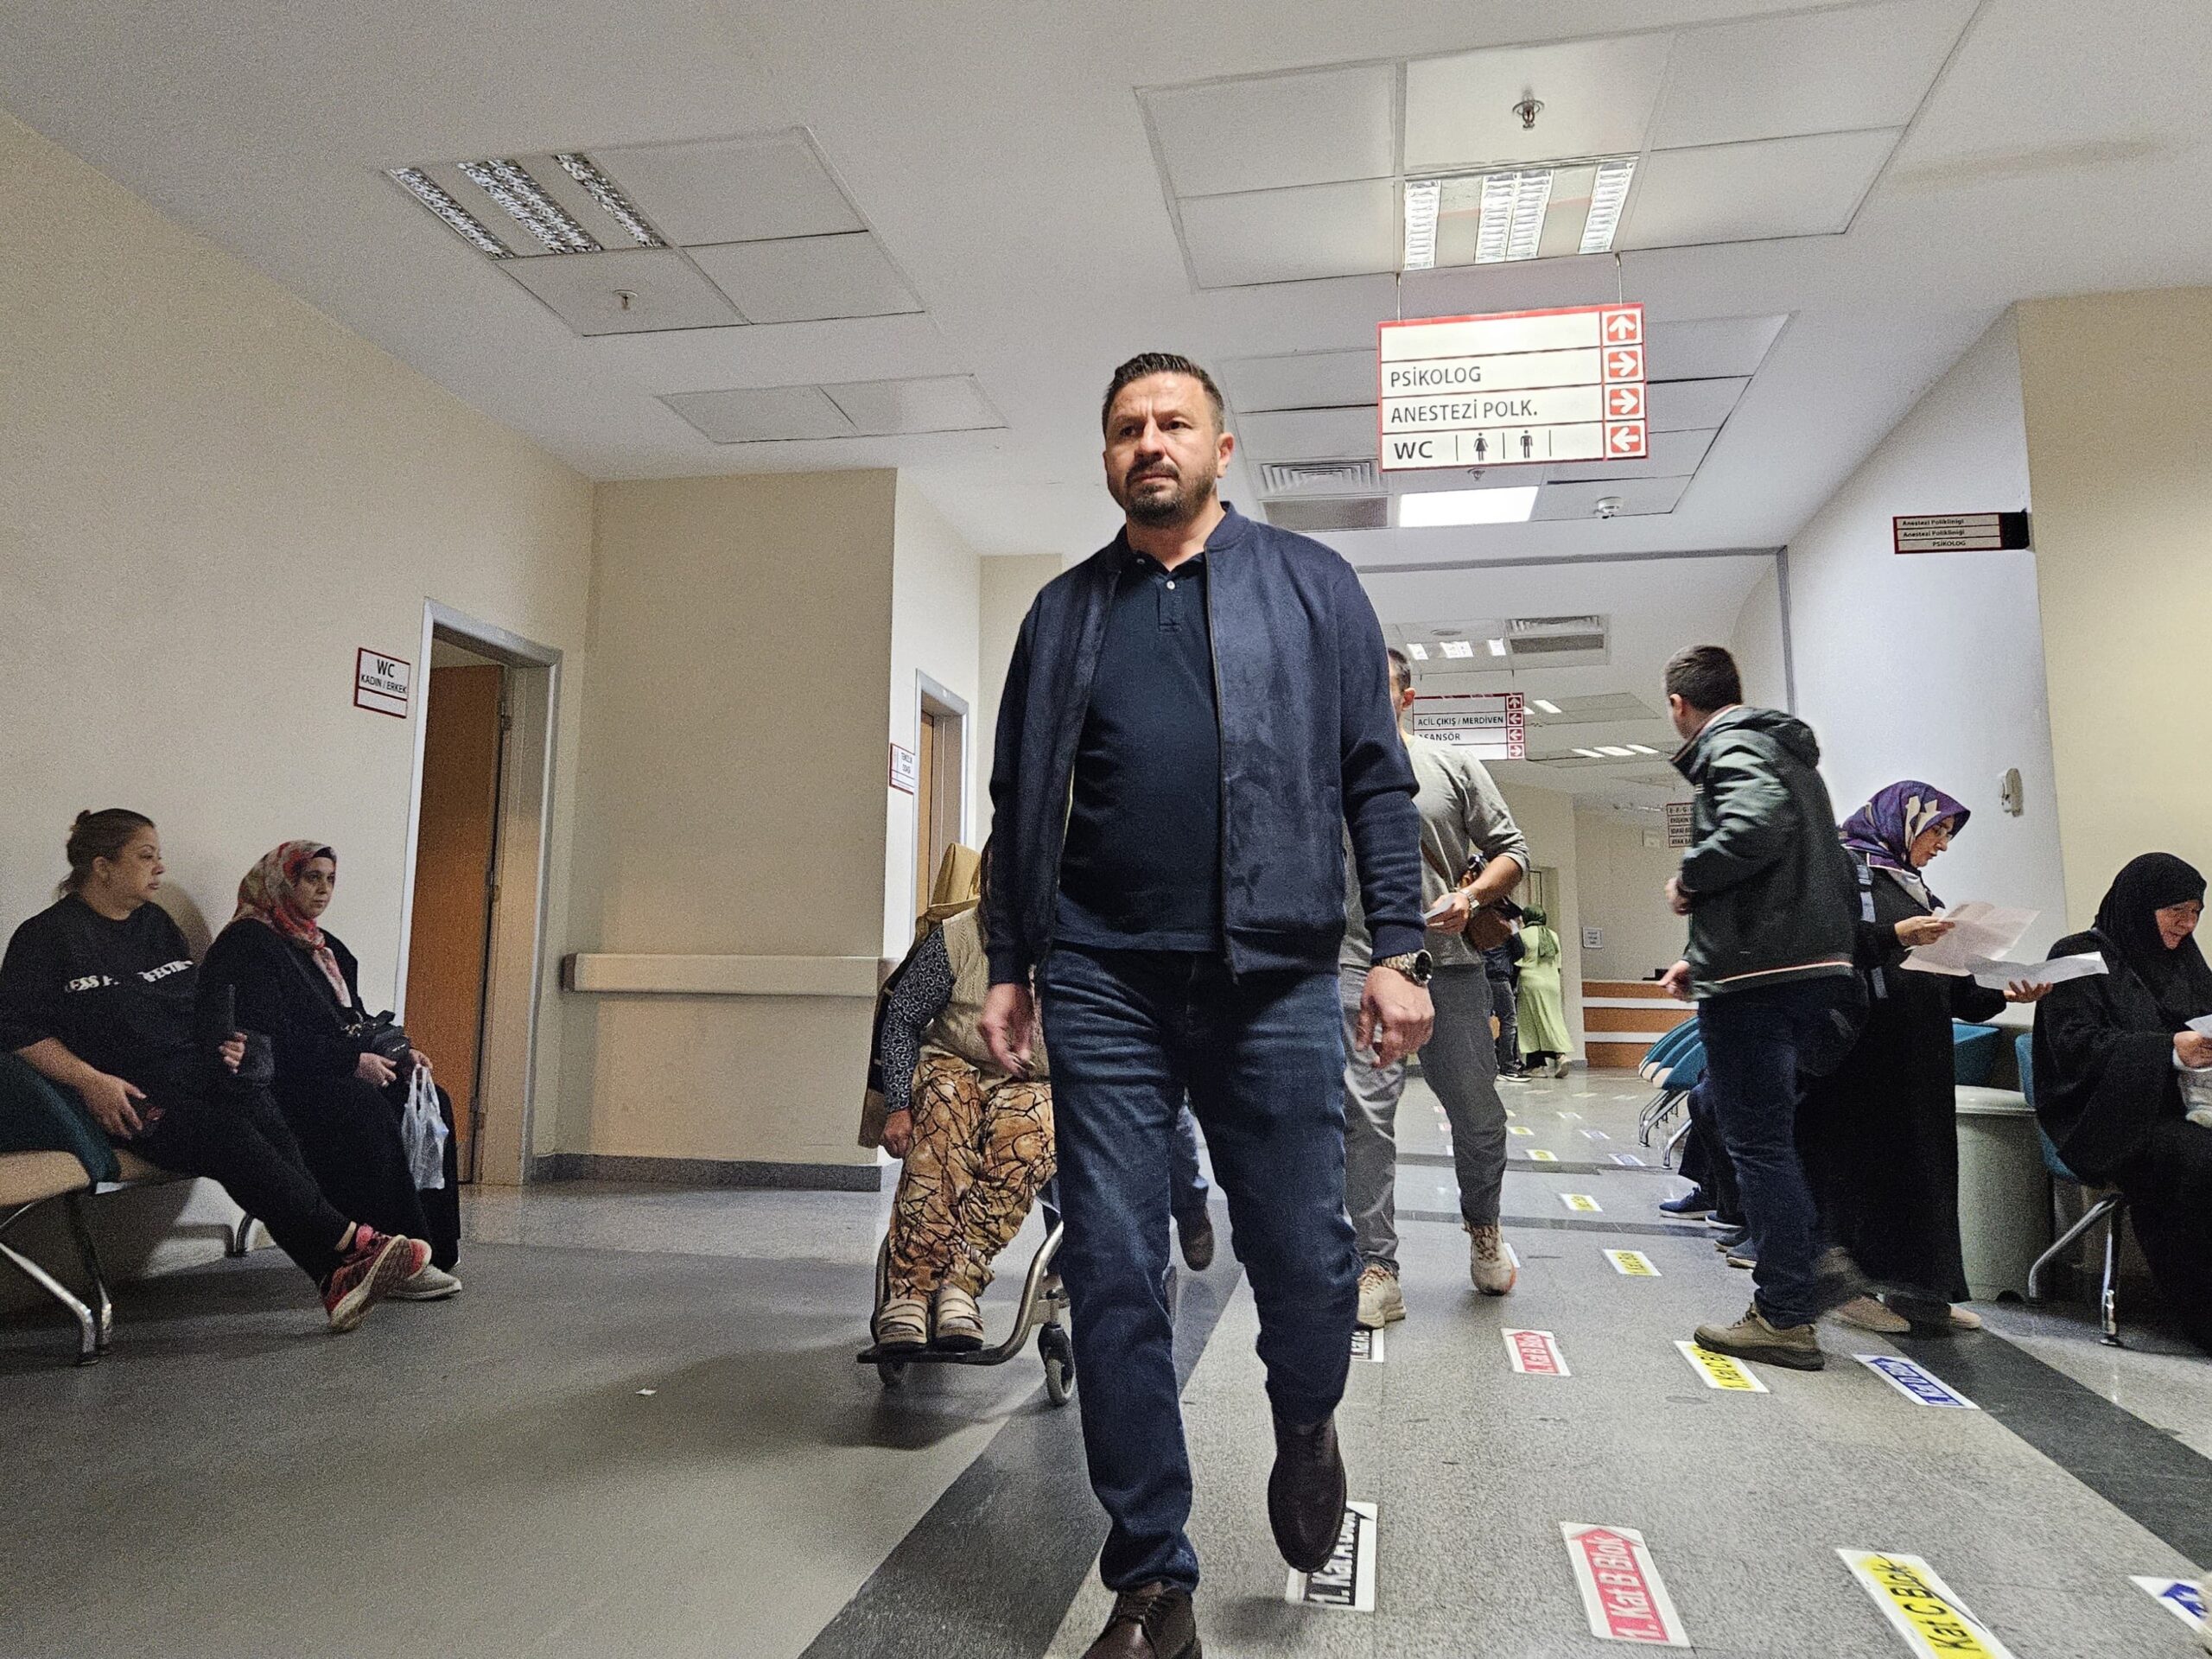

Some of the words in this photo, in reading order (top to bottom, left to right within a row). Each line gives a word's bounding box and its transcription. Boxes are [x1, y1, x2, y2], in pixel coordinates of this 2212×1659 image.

[1390, 366, 1482, 388] PSİKOLOG
[1391, 399, 1477, 423] ANESTEZİ
[1484, 399, 1538, 419] POLK.
[1394, 441, 1433, 460] WC
[377, 659, 395, 678] WC
[361, 674, 382, 688] KADIN
[386, 681, 407, 694] ERKEK
[1418, 716, 1434, 726] ACİL
[1436, 716, 1456, 727] ÇIKIŞ
[1462, 715, 1503, 725] MERDİVEN
[1710, 1369, 1743, 1381] Kat
[1586, 1535, 1634, 1571] Blok
[1596, 1571, 1641, 1586] B
[1872, 1563, 1936, 1599] Blok
[1307, 1588, 1350, 1603] 1.
[1605, 1586, 1655, 1619] Kat
[1903, 1603, 1948, 1615] C
[1611, 1621, 1662, 1639] 1.
[1919, 1619, 1983, 1652] Kat
